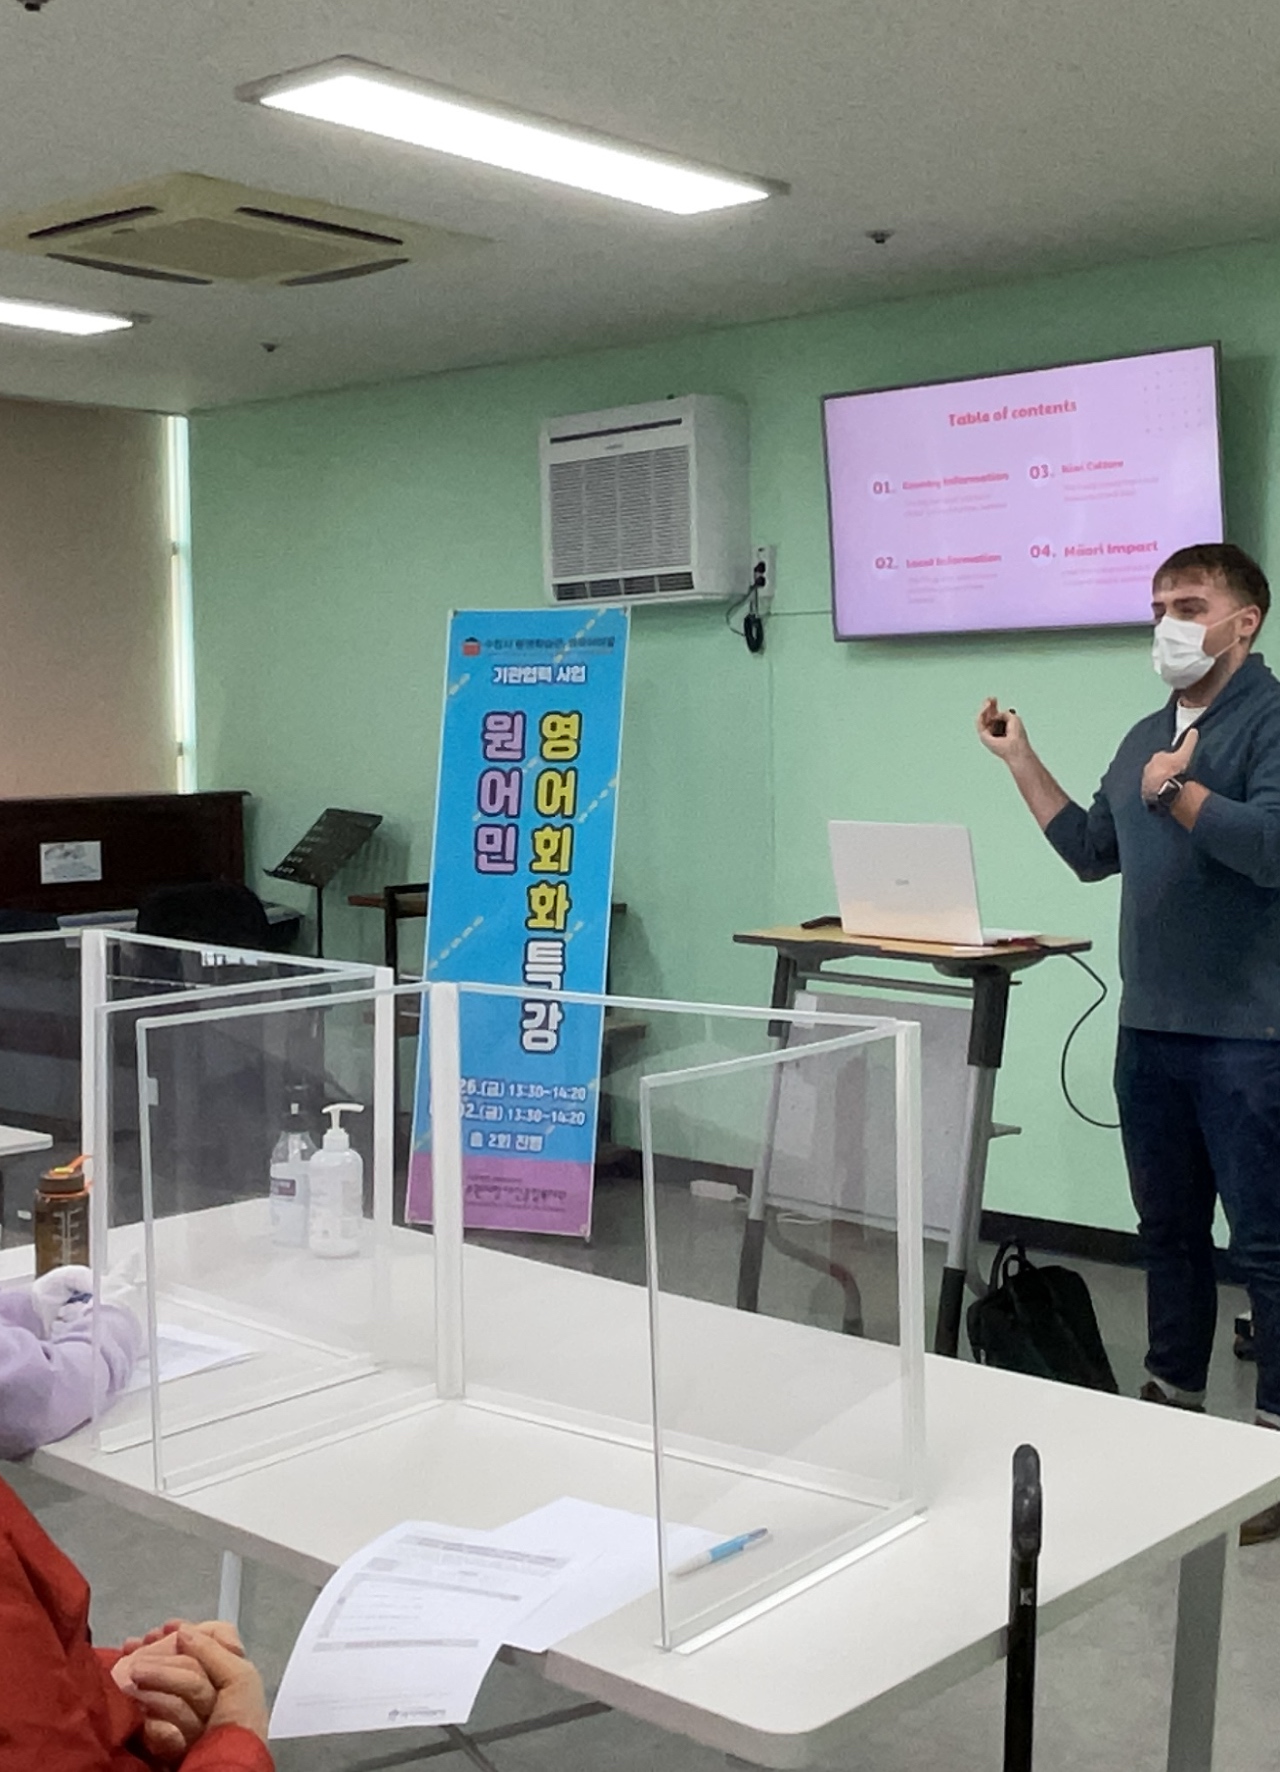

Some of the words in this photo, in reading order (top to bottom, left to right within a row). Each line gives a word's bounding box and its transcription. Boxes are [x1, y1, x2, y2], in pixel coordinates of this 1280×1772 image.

[949, 407, 990, 427] Table
[993, 400, 1008, 420] of
[1011, 398, 1077, 419] contents
[1030, 544, 1056, 558] 04.
[1107, 540, 1158, 555] Impact
[556, 664, 586, 684] 사업
[476, 711, 525, 874] 원어민
